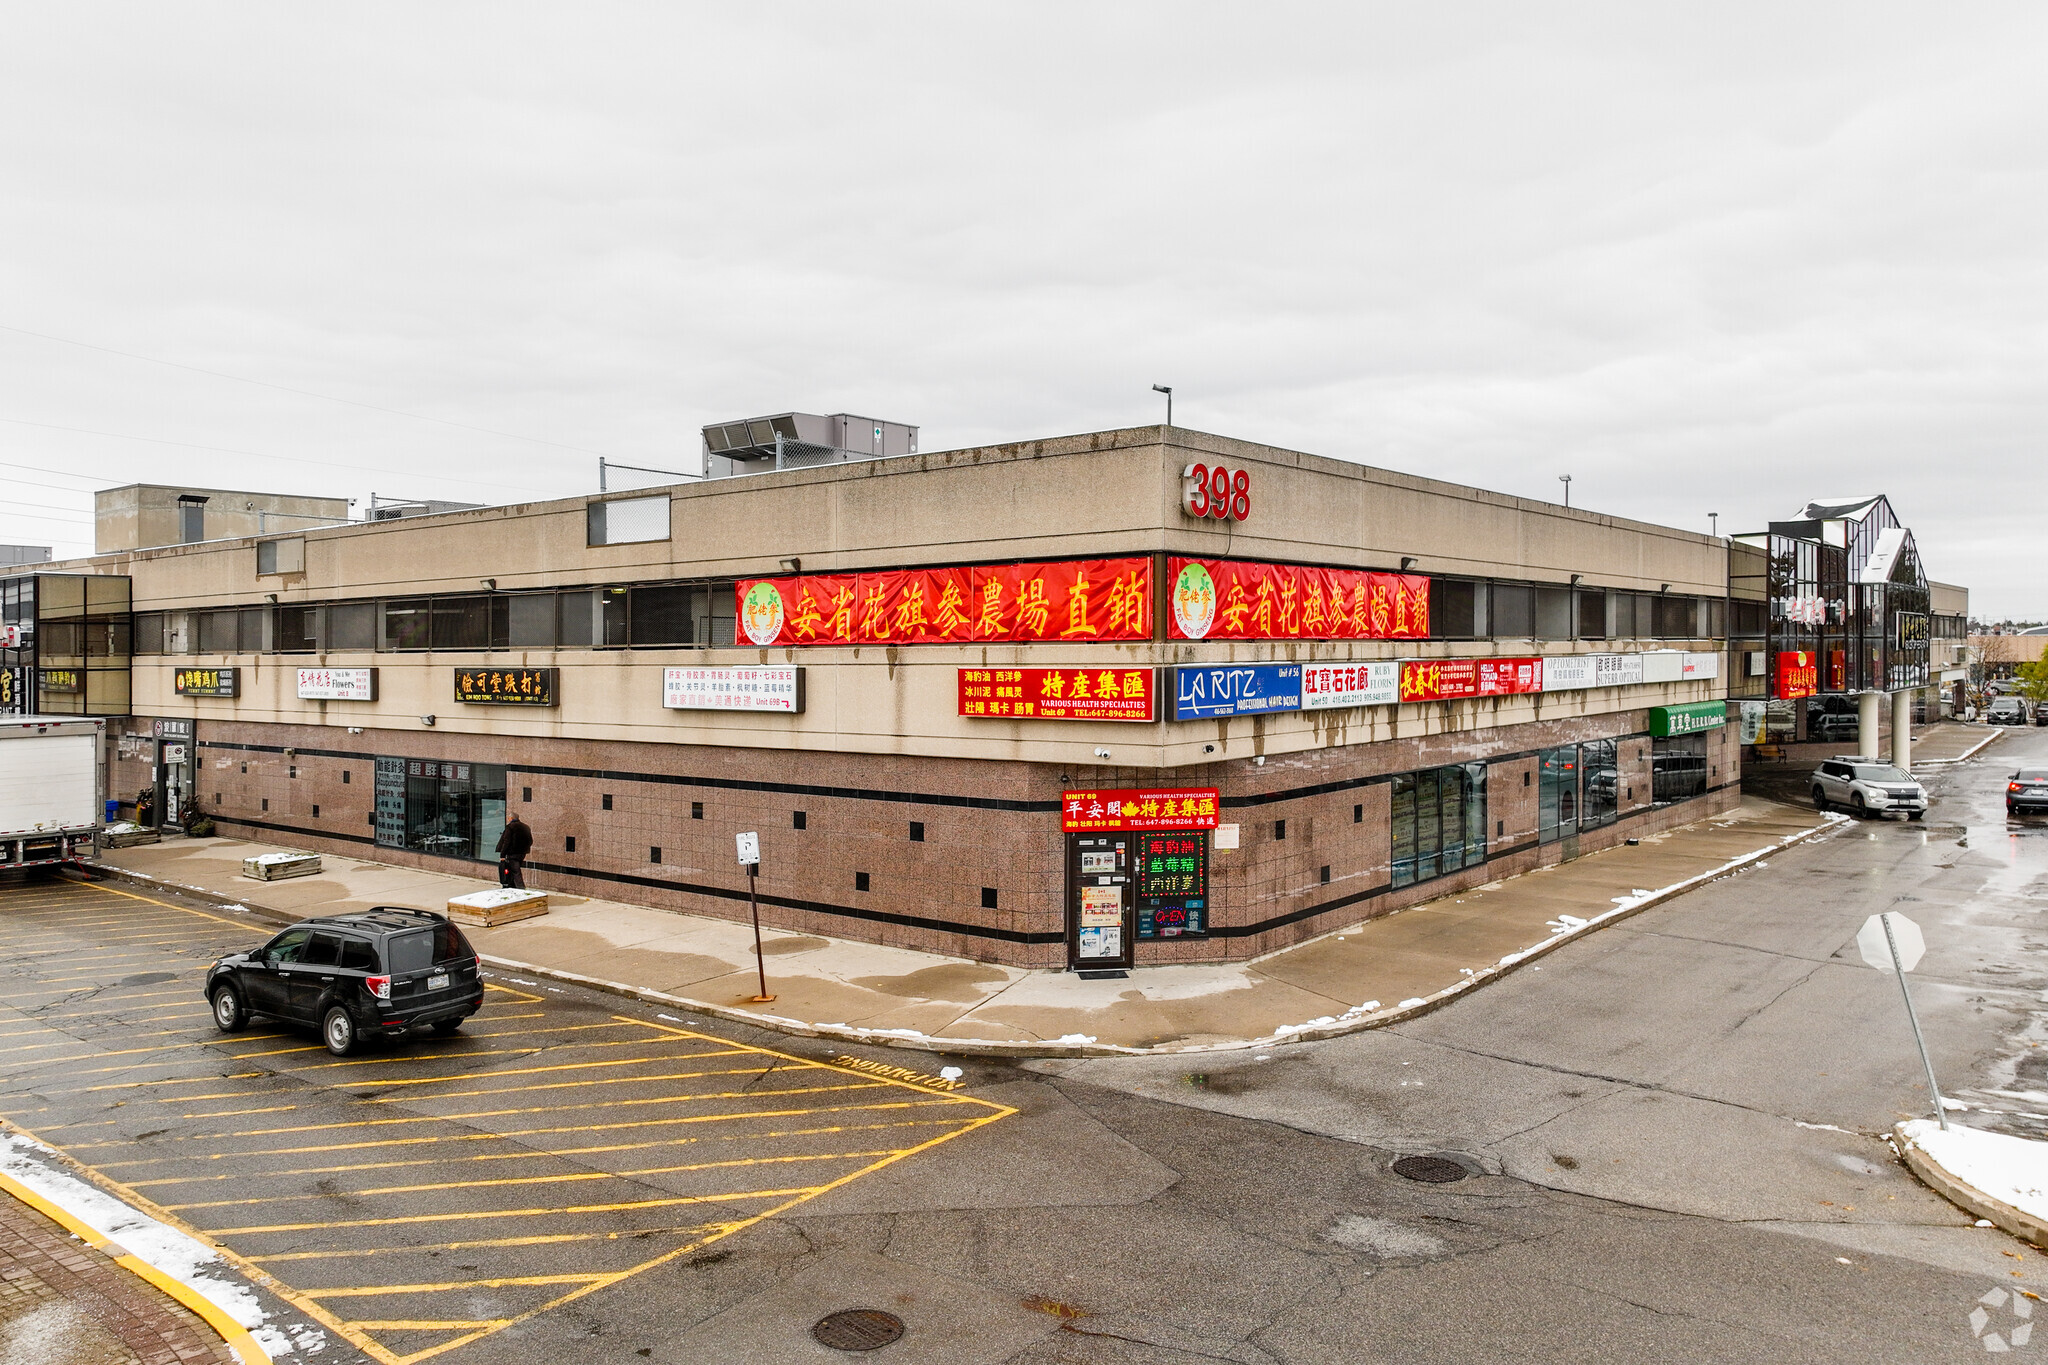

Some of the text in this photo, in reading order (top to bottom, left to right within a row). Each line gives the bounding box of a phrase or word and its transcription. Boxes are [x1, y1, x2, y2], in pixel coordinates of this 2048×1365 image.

[1184, 463, 1251, 522] 398
[1183, 624, 1194, 636] BOY
[1195, 608, 1213, 636] GINSENG
[751, 632, 762, 642] BOY
[764, 618, 781, 643] GINSENG
[1481, 663, 1494, 672] HELLO
[1548, 658, 1590, 669] OPTOMETRIST
[965, 671, 991, 682] 海豹油
[1374, 666, 1391, 676] RUBY
[1481, 672, 1497, 681] TOMATO
[1305, 666, 1368, 694] 紅寶石花廊
[1370, 678, 1395, 689] FLORIST
[1400, 664, 1440, 698] 長春行
[1598, 672, 1618, 685] SUPERB
[1619, 671, 1640, 683] OPTICAL
[332, 679, 355, 689] Flowers
[965, 687, 991, 698] 冰川泥
[1179, 672, 1205, 715] LA
[1211, 670, 1256, 699] RITZ
[756, 698, 768, 706] Unit
[1041, 700, 1071, 708] VARIOUS
[1100, 701, 1145, 709] SPECIALTIES
[1268, 696, 1283, 708] HAIR
[1311, 697, 1321, 705] Unit
[1056, 709, 1065, 717] 69
[830, 1054, 930, 1083] PARKING
